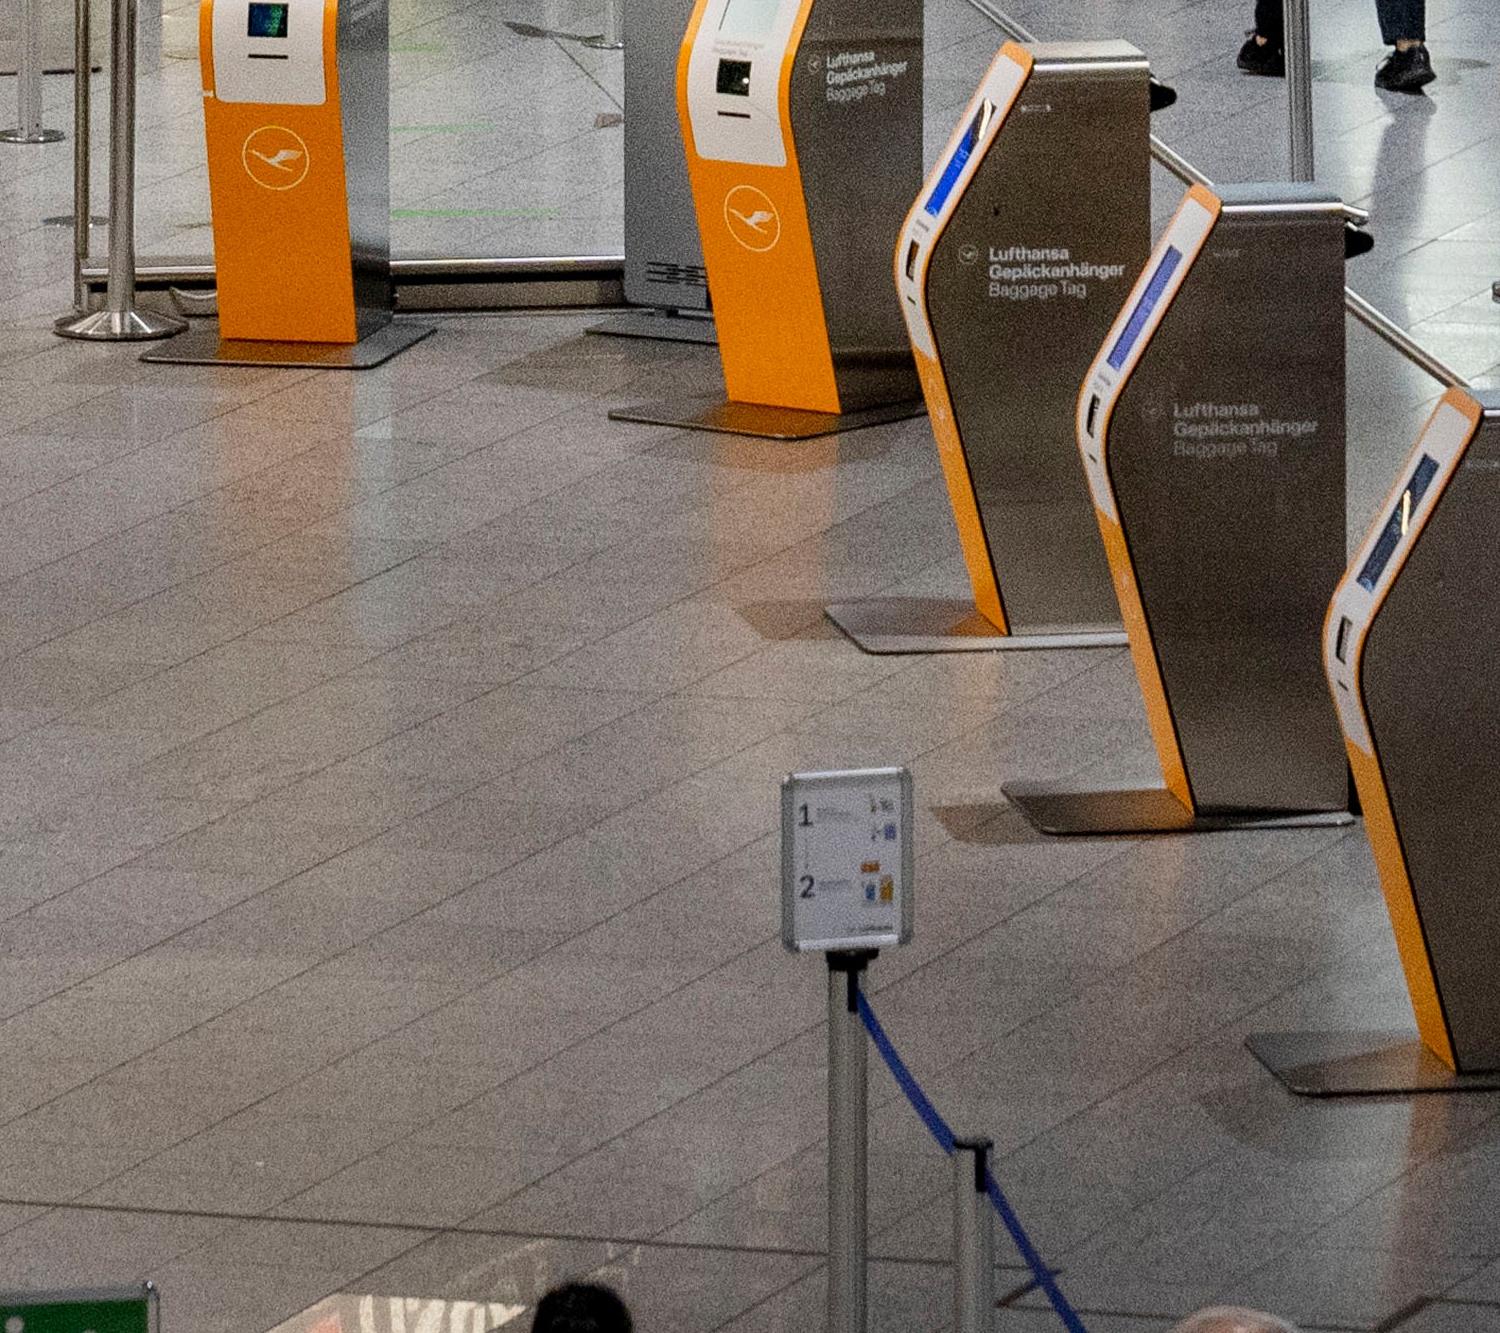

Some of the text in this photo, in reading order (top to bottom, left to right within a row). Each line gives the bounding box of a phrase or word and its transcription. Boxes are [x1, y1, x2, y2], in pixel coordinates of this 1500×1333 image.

[825, 52, 876, 74] Lufthansa
[825, 61, 908, 88] Gepäckanhänger
[825, 73, 887, 104] Baggage Tag
[988, 245, 1069, 262] Lufthansa
[988, 261, 1126, 283] Gepäckanhänger
[988, 279, 1088, 301] Baggage Tag
[1172, 399, 1259, 419] Lufthansa
[1172, 418, 1320, 441] Gepäckanhänger
[800, 805, 812, 828] 1
[799, 875, 815, 901] 2
